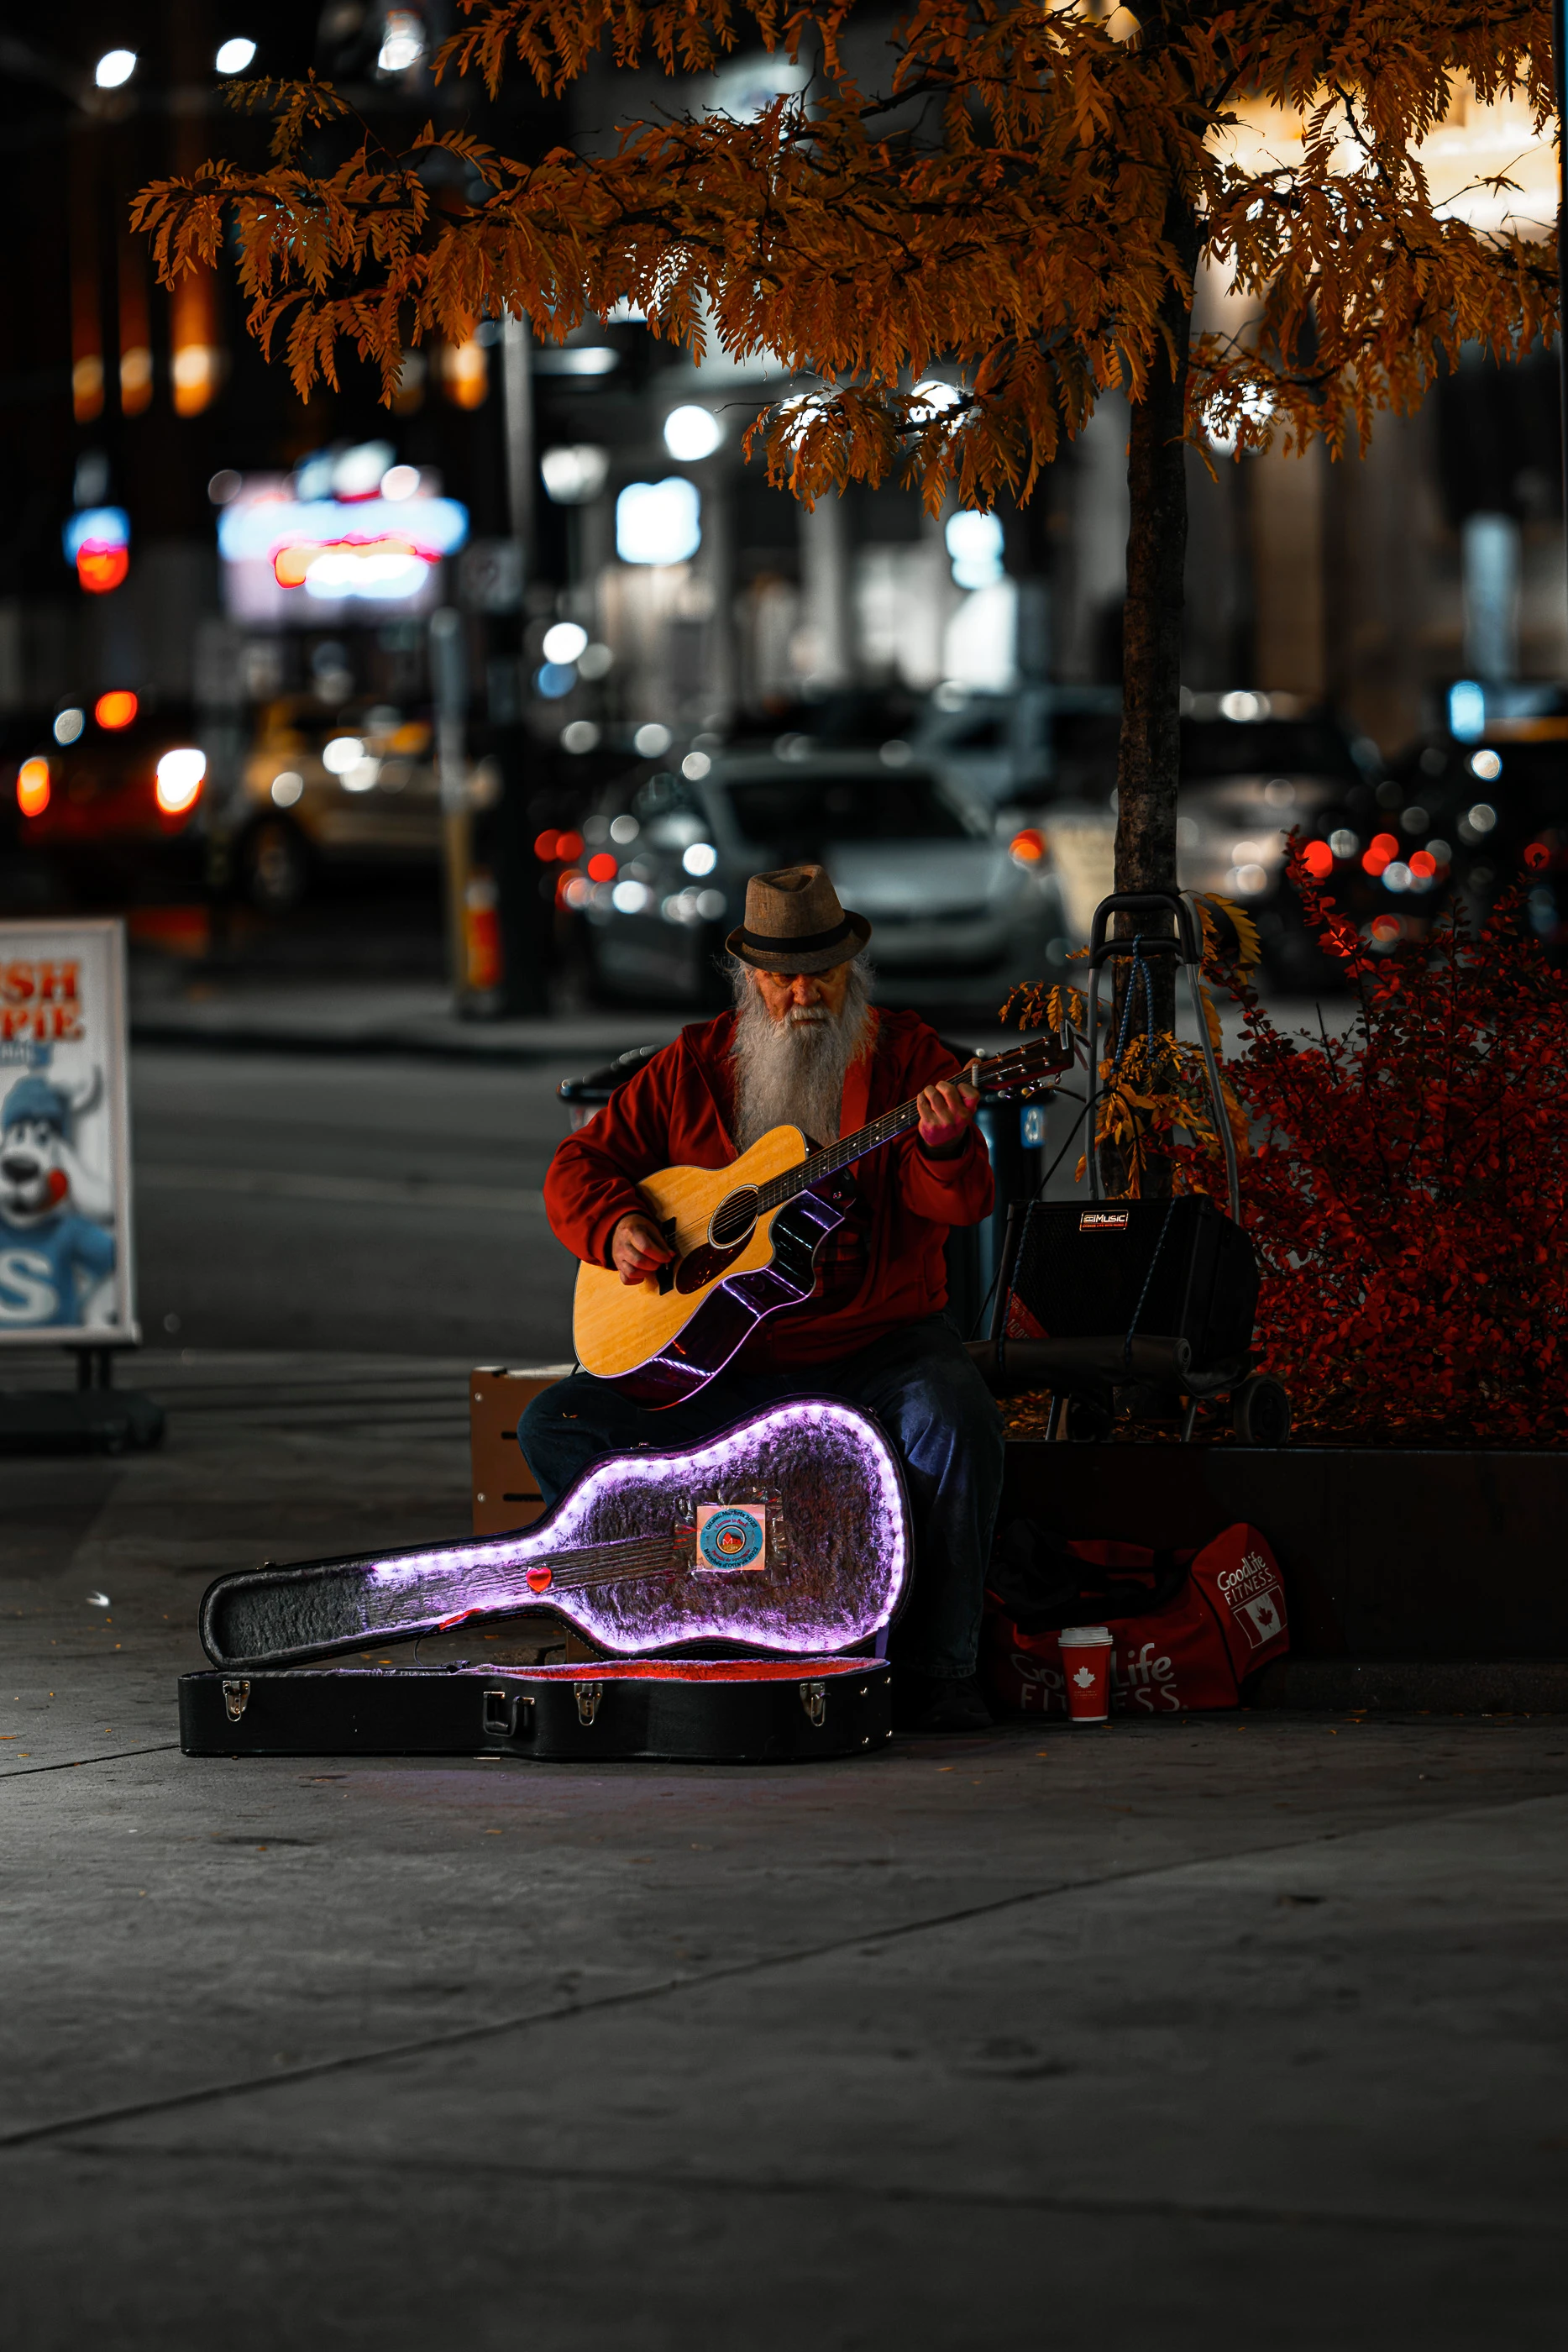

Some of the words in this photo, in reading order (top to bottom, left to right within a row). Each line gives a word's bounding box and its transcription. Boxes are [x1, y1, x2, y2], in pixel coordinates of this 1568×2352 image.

[0, 1247, 57, 1323] S
[705, 1514, 722, 1530] Ottawa
[721, 1509, 745, 1518] Markets
[745, 1515, 758, 1529] 2022
[747, 1546, 759, 1561] 2022
[1217, 1551, 1266, 1591] GoodLife
